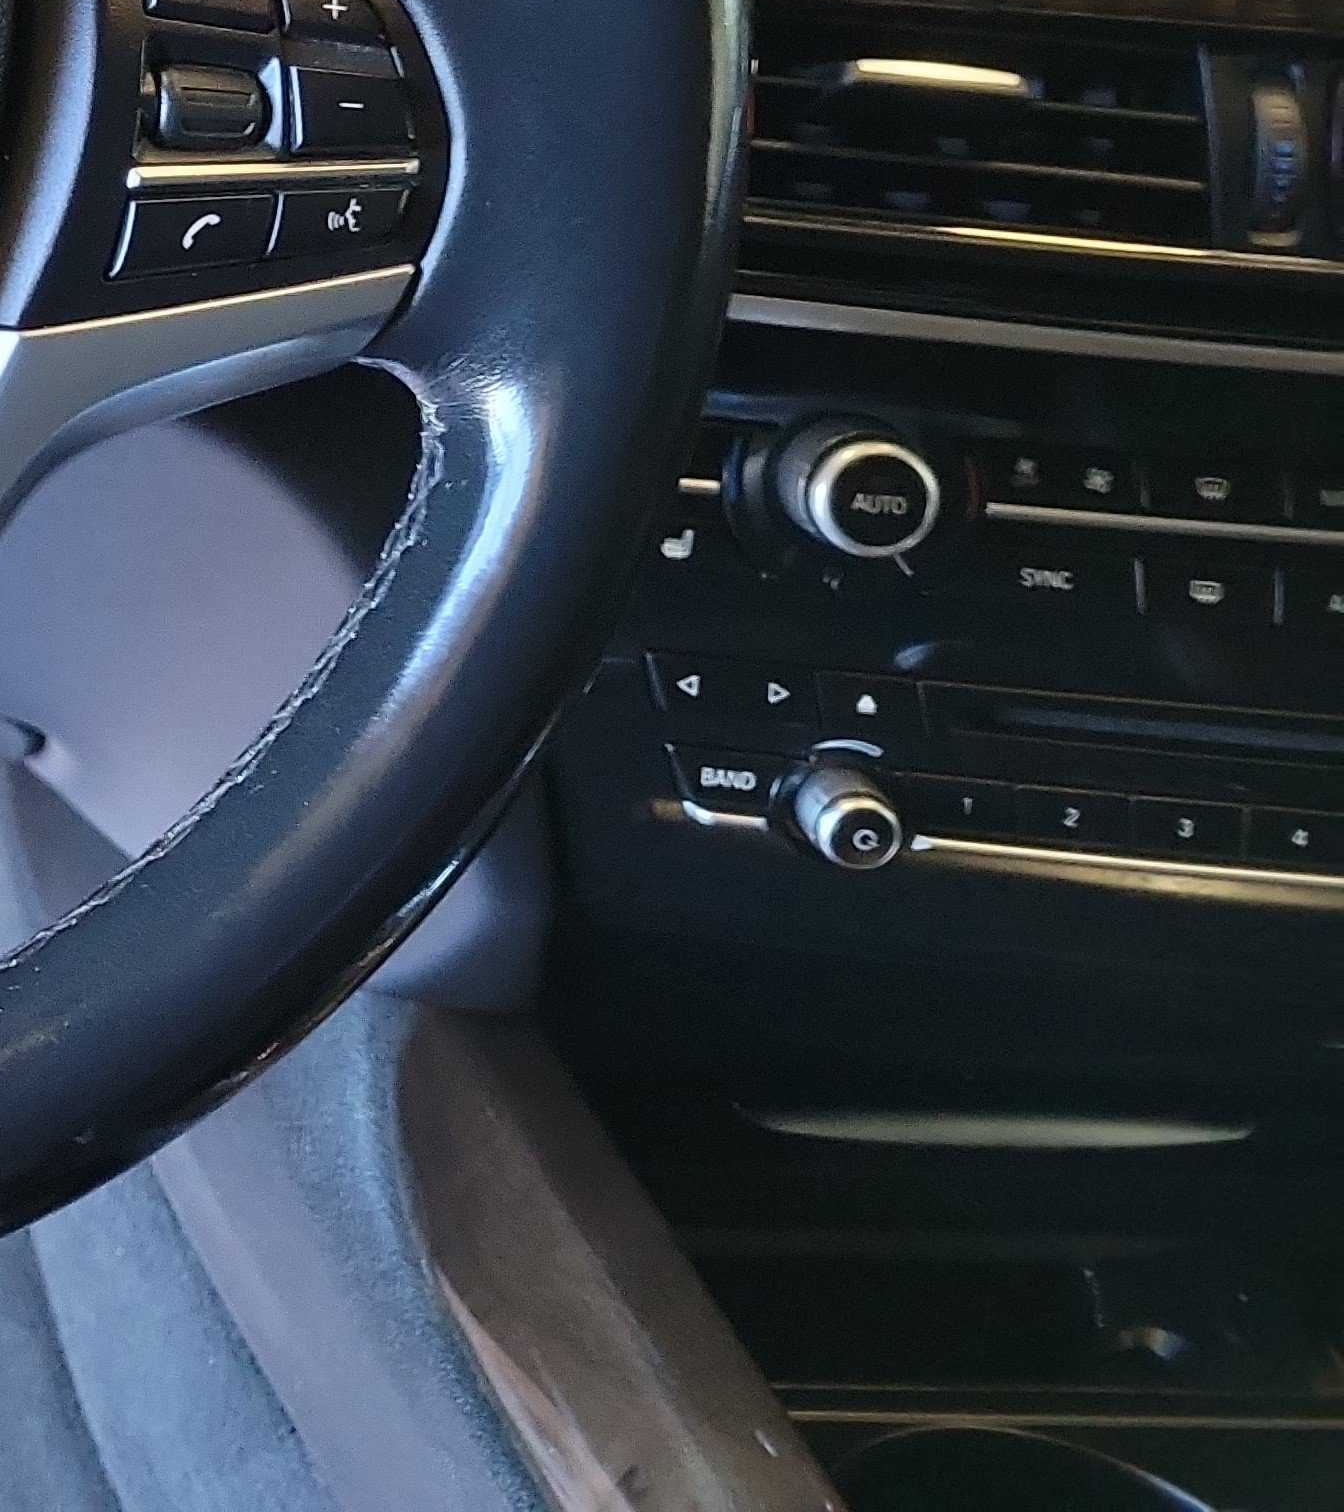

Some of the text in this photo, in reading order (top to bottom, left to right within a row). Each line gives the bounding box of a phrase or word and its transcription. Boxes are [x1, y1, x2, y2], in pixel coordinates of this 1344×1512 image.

[851, 493, 907, 515] AUTO
[1019, 567, 1074, 590] SYNC
[700, 767, 757, 791] BAND
[963, 797, 972, 815] 1
[1063, 807, 1081, 827] 2
[1177, 817, 1195, 838] 3
